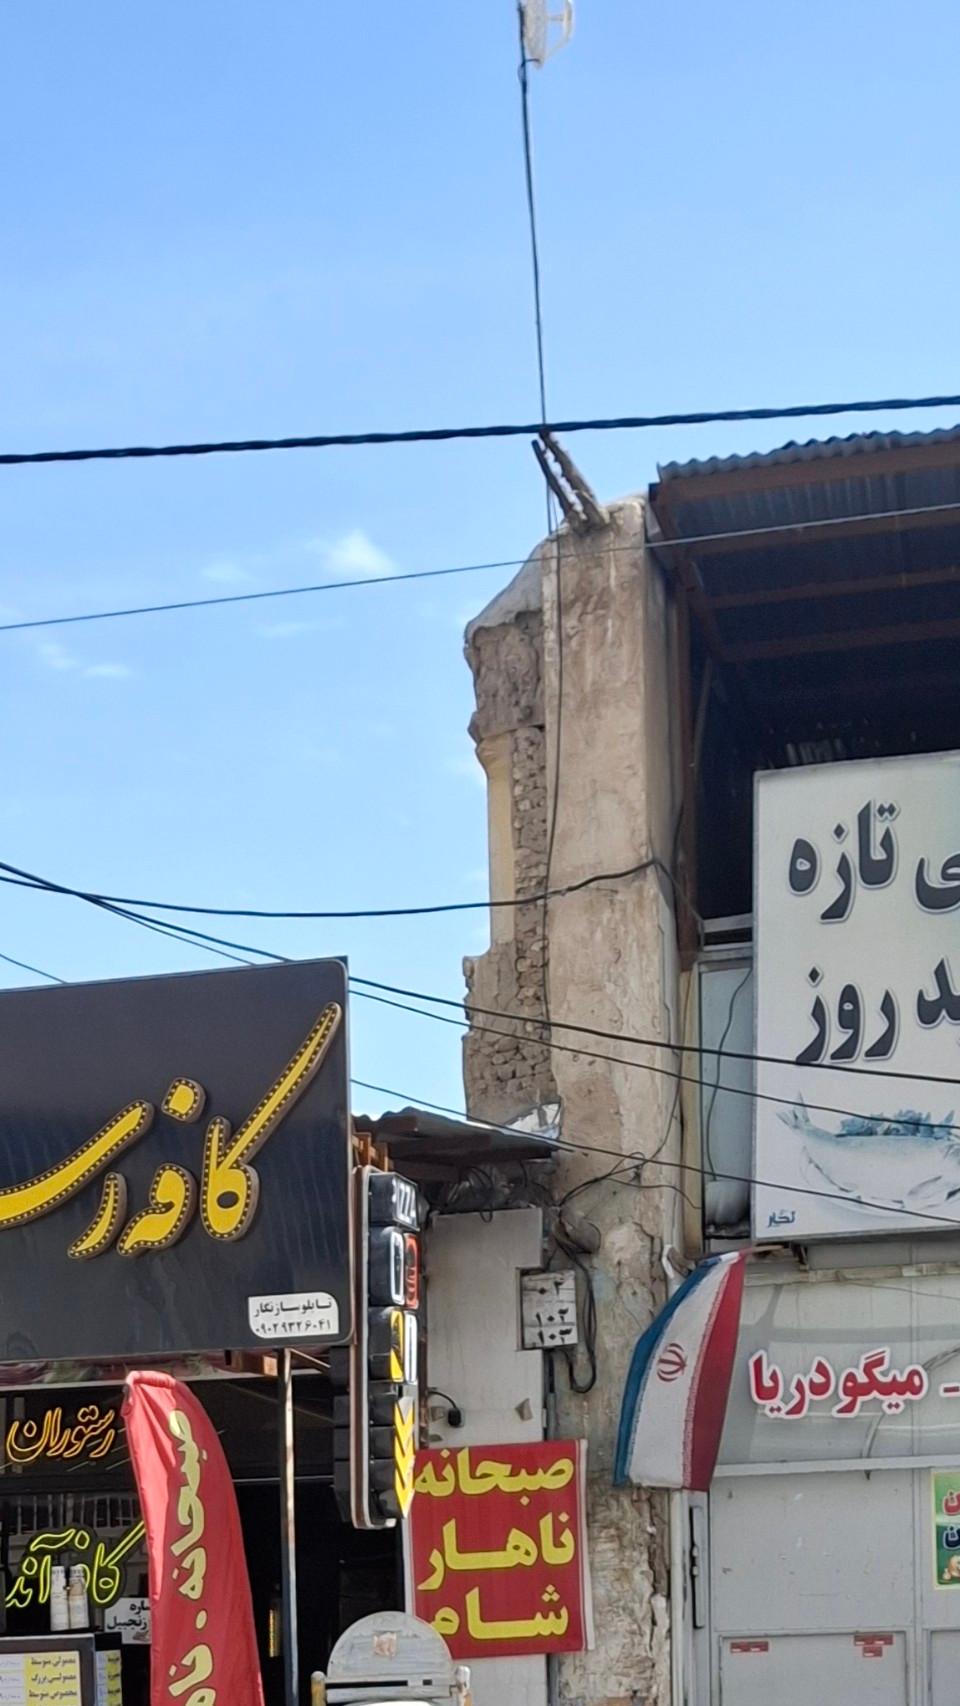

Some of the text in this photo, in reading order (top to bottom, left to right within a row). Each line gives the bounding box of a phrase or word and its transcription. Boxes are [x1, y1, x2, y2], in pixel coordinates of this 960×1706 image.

[788, 799, 897, 921] تازه
[795, 966, 897, 1064] روز
[117, 1001, 342, 1258] کافه
[5, 1404, 117, 1464] رستوران
[169, 1408, 208, 1602] صبحانه
[414, 1447, 574, 1507] صبحانه
[416, 1511, 576, 1591] ناهار
[106, 1615, 148, 1631] زنجبیل
[429, 1583, 569, 1640] شام
